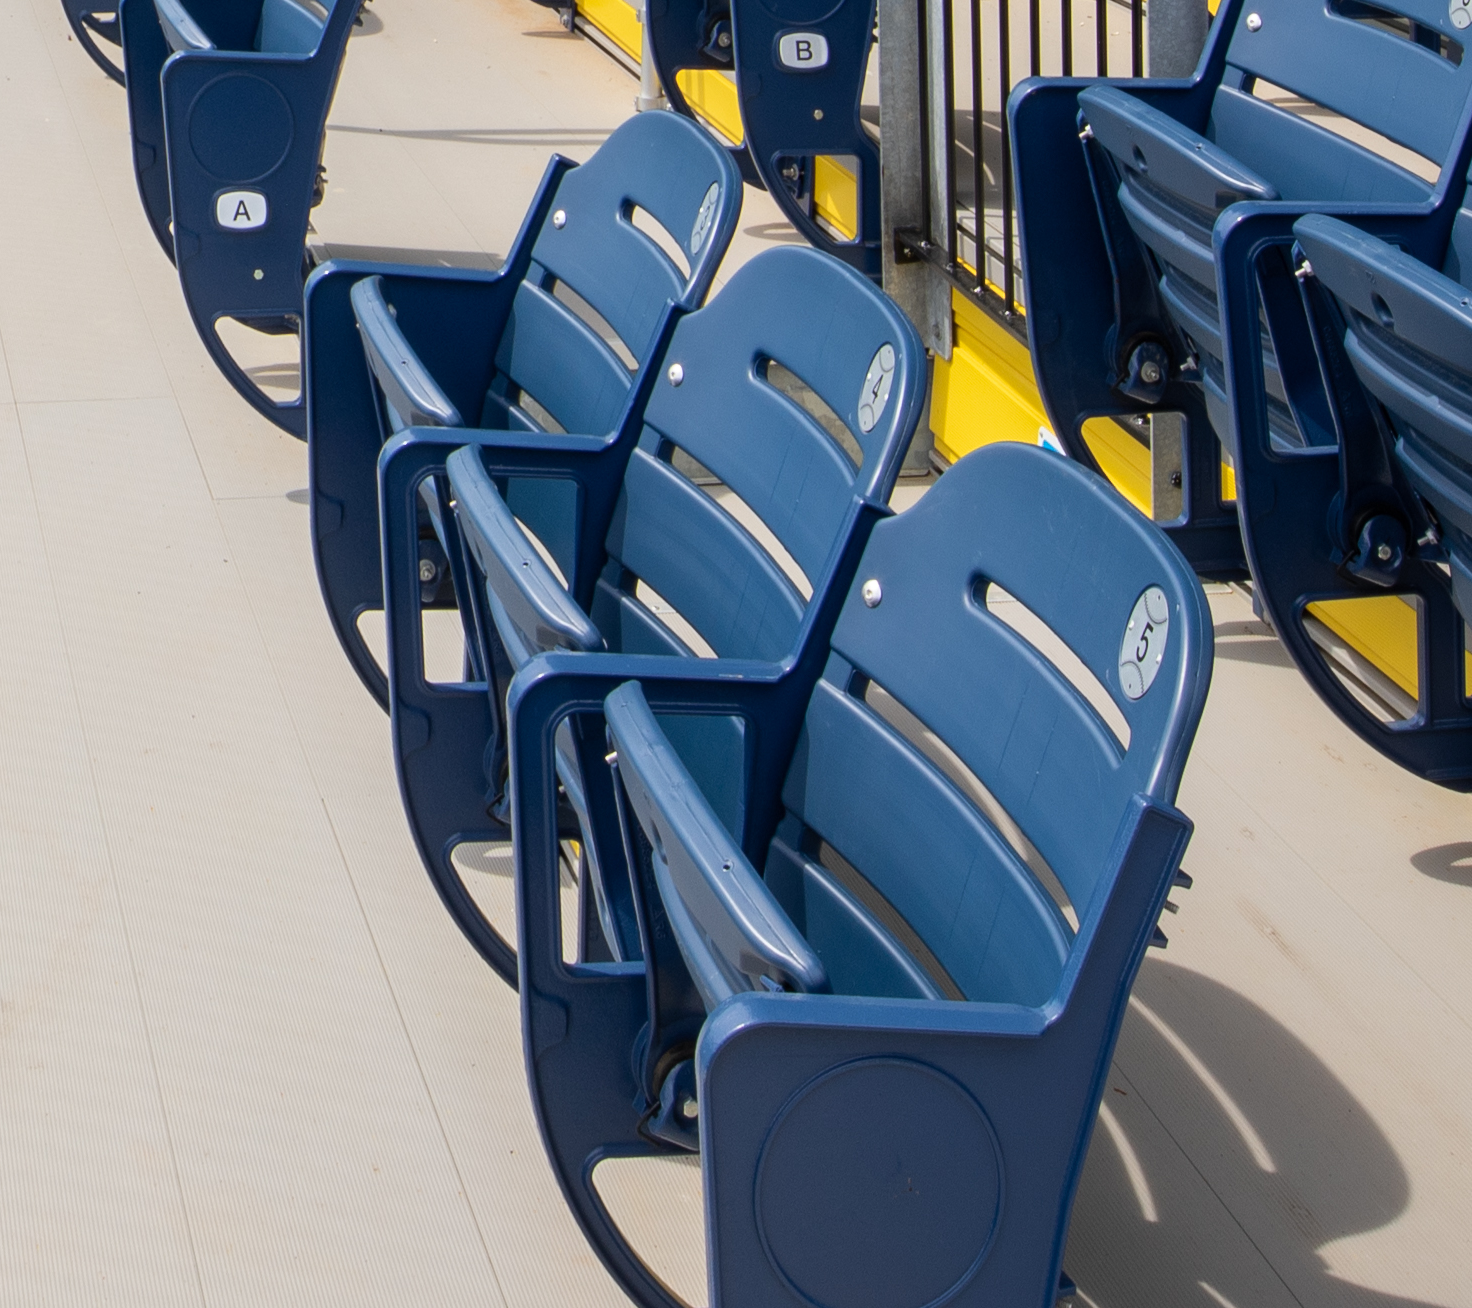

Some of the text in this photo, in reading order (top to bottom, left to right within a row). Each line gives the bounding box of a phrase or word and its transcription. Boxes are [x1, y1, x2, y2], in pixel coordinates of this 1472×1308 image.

[795, 40, 813, 61] B
[233, 199, 251, 221] A
[872, 374, 884, 404] 4
[1136, 621, 1154, 663] 5
